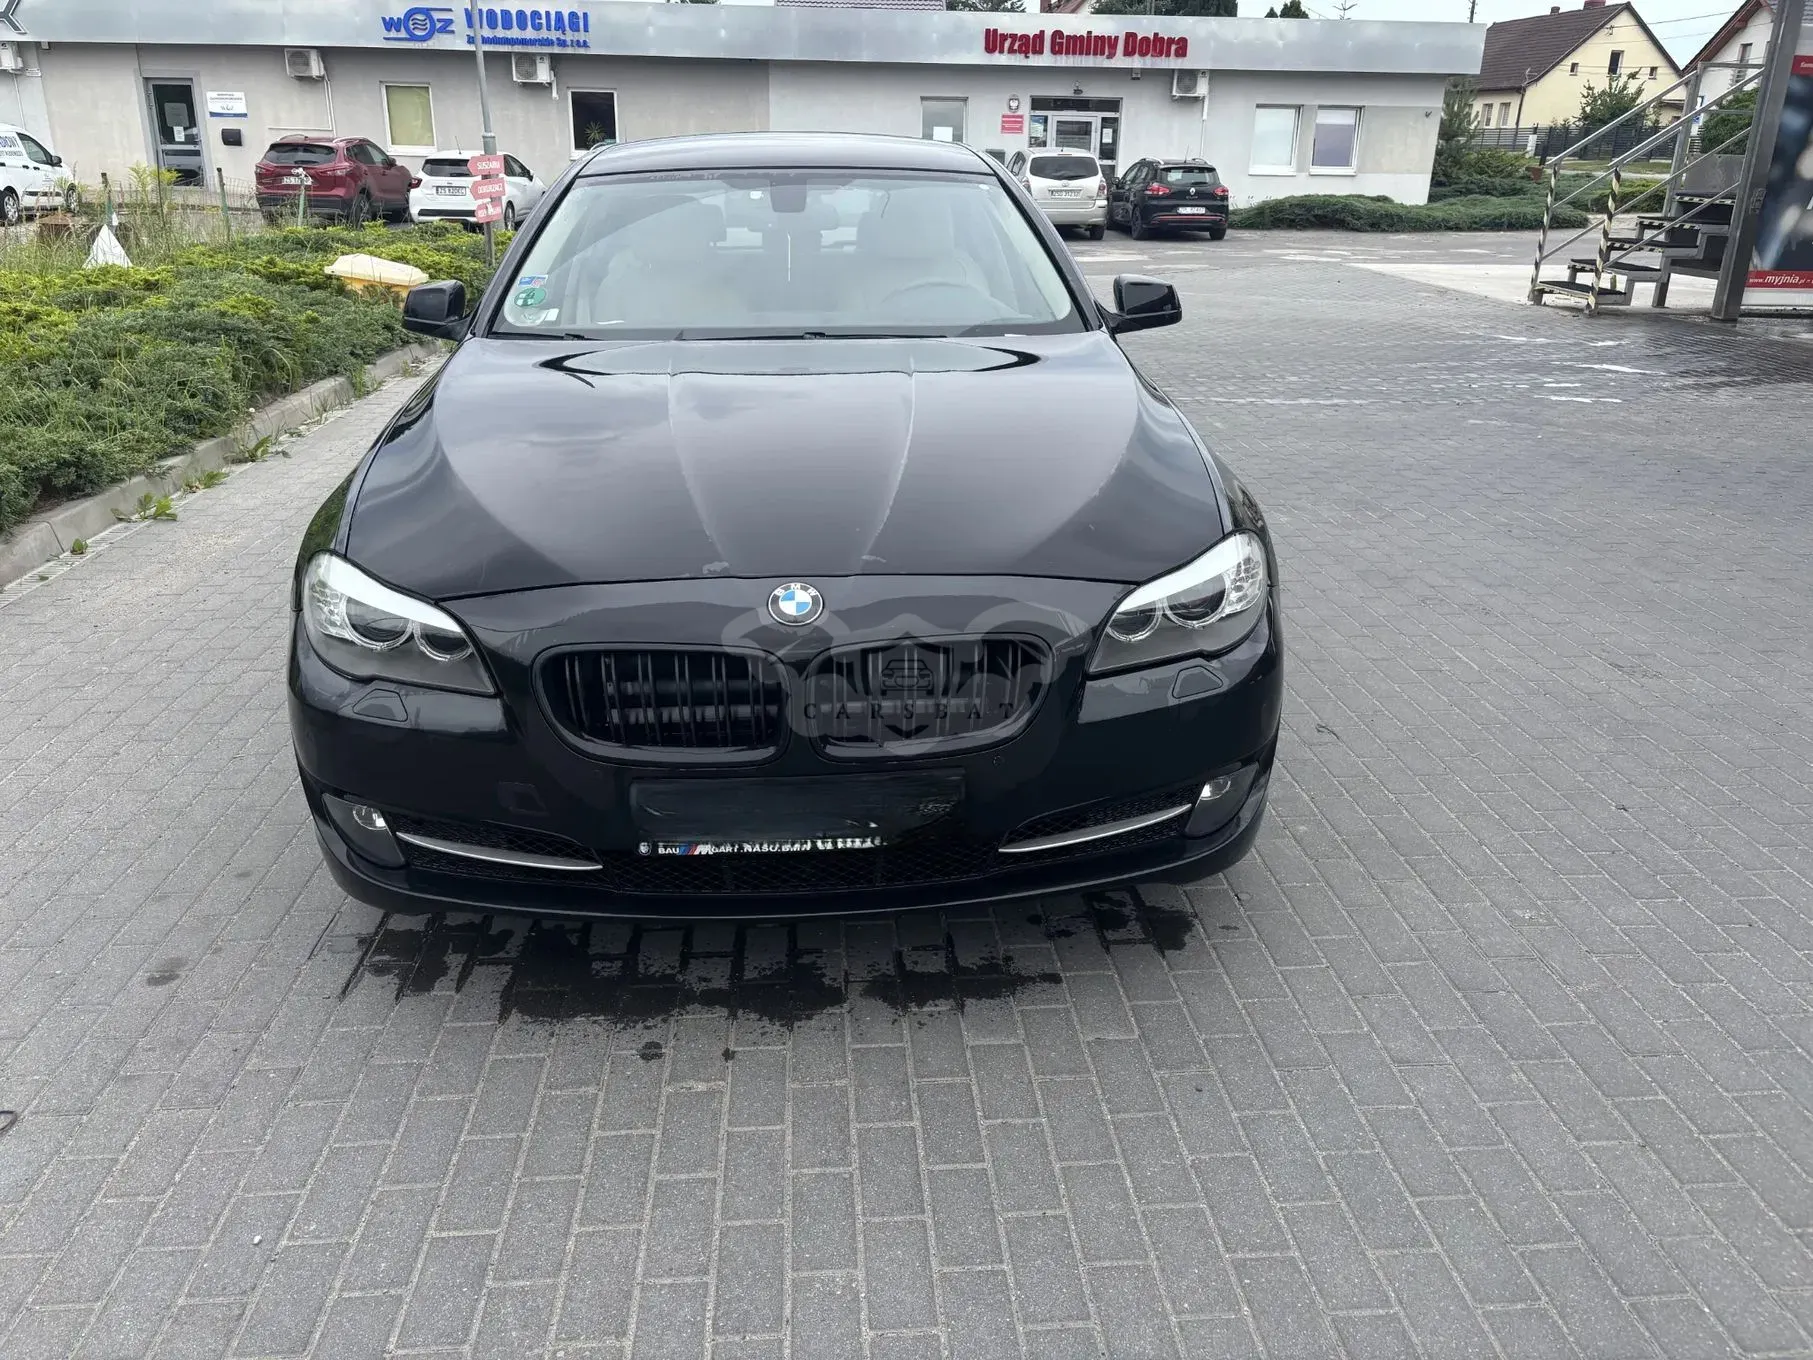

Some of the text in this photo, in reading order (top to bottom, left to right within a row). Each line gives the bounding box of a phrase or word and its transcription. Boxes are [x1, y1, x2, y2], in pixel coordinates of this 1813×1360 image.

[984, 28, 1188, 59] Urząd Gminy Dobra
